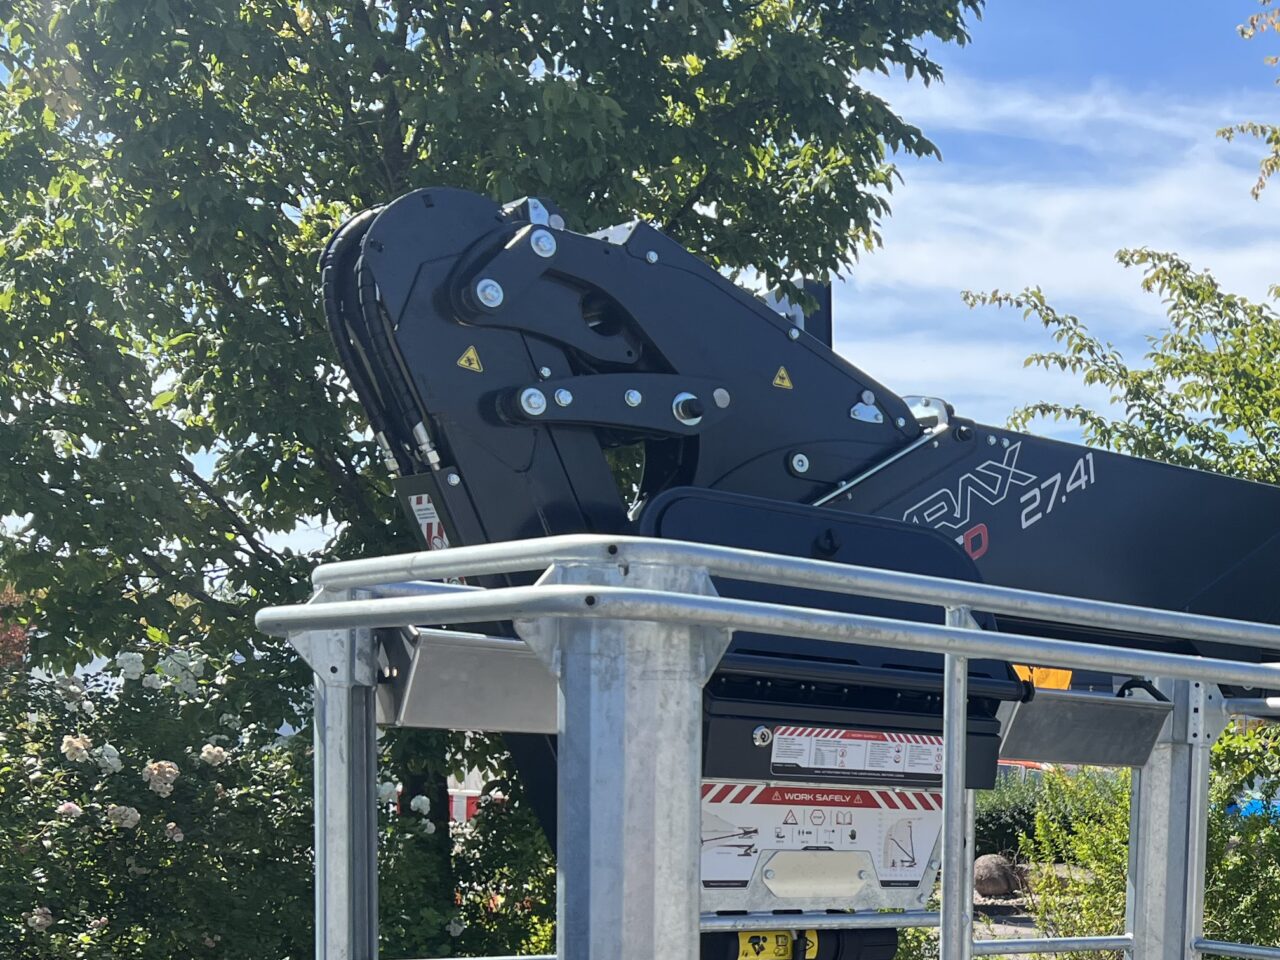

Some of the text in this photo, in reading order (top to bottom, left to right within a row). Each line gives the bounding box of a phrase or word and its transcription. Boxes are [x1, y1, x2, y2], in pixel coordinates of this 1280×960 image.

[903, 441, 1038, 529] RAX
[1020, 452, 1095, 529] 27.41
[784, 792, 851, 802] WORK SAFELY
